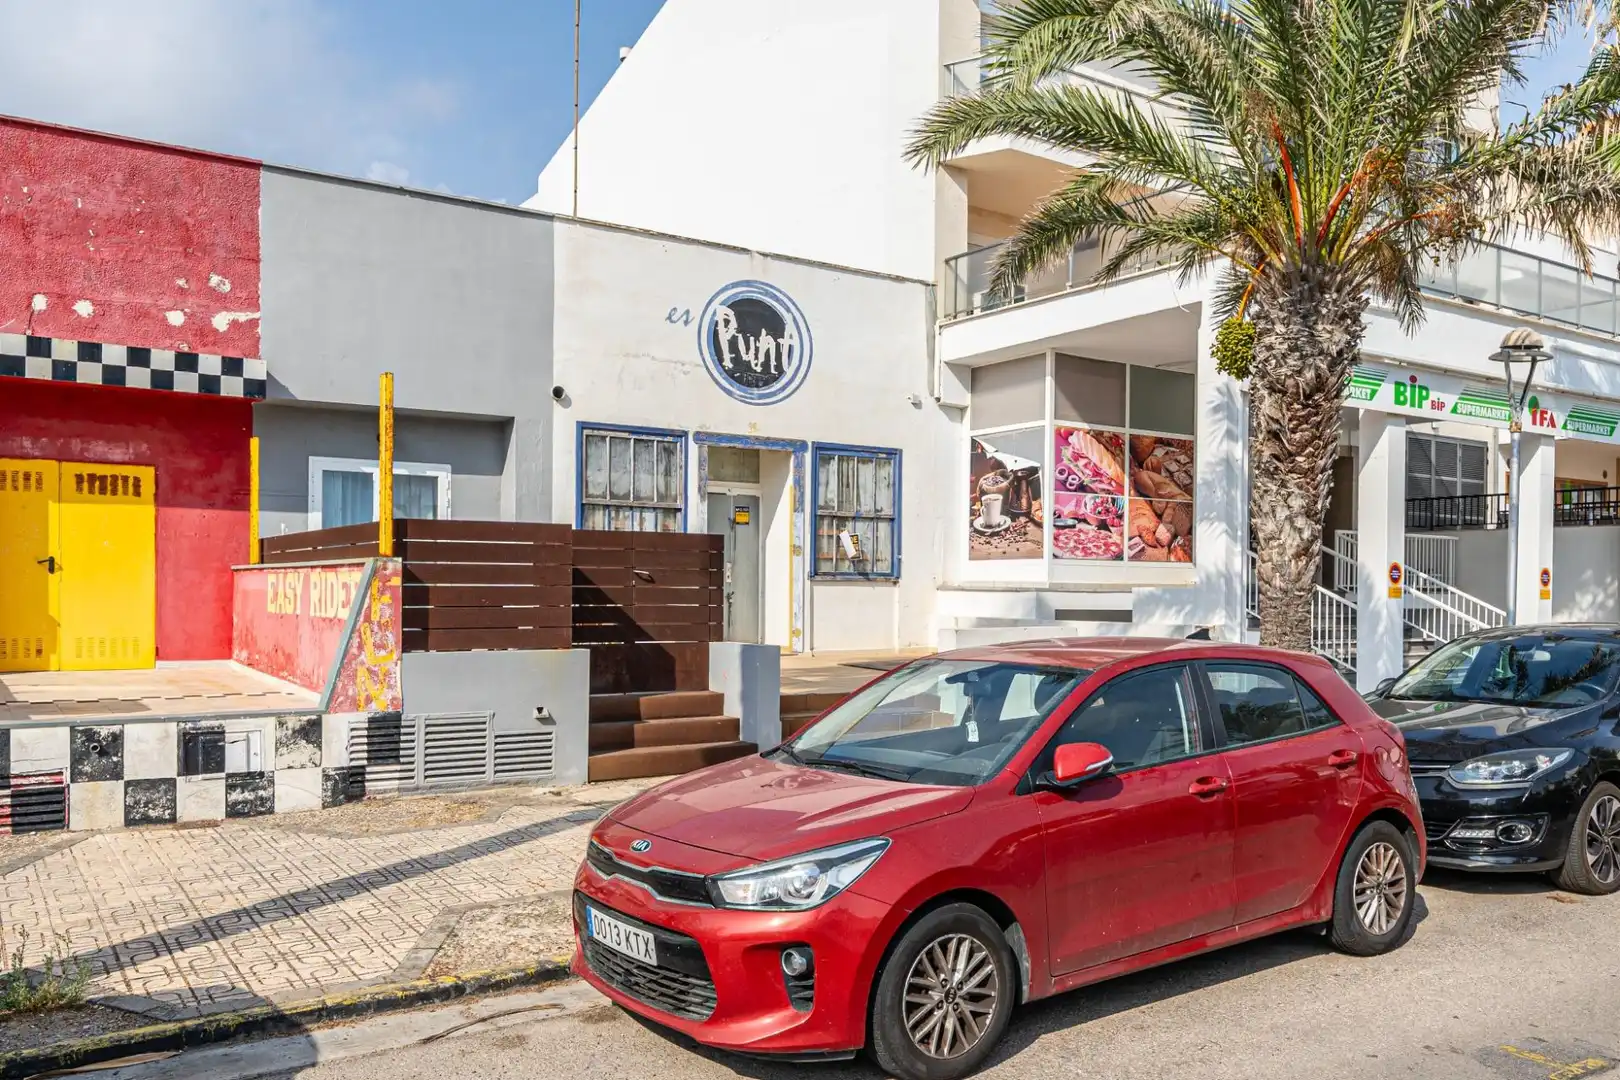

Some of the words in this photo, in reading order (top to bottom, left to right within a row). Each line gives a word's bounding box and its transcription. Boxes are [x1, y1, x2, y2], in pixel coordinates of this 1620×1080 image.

[665, 306, 696, 327] es
[715, 304, 796, 374] Punt
[1456, 402, 1510, 421] SUPERMARKET
[1566, 419, 1611, 435] SUPERMARKET
[267, 572, 304, 615] EASY
[593, 914, 621, 947] 0013
[624, 928, 652, 960] KTX
